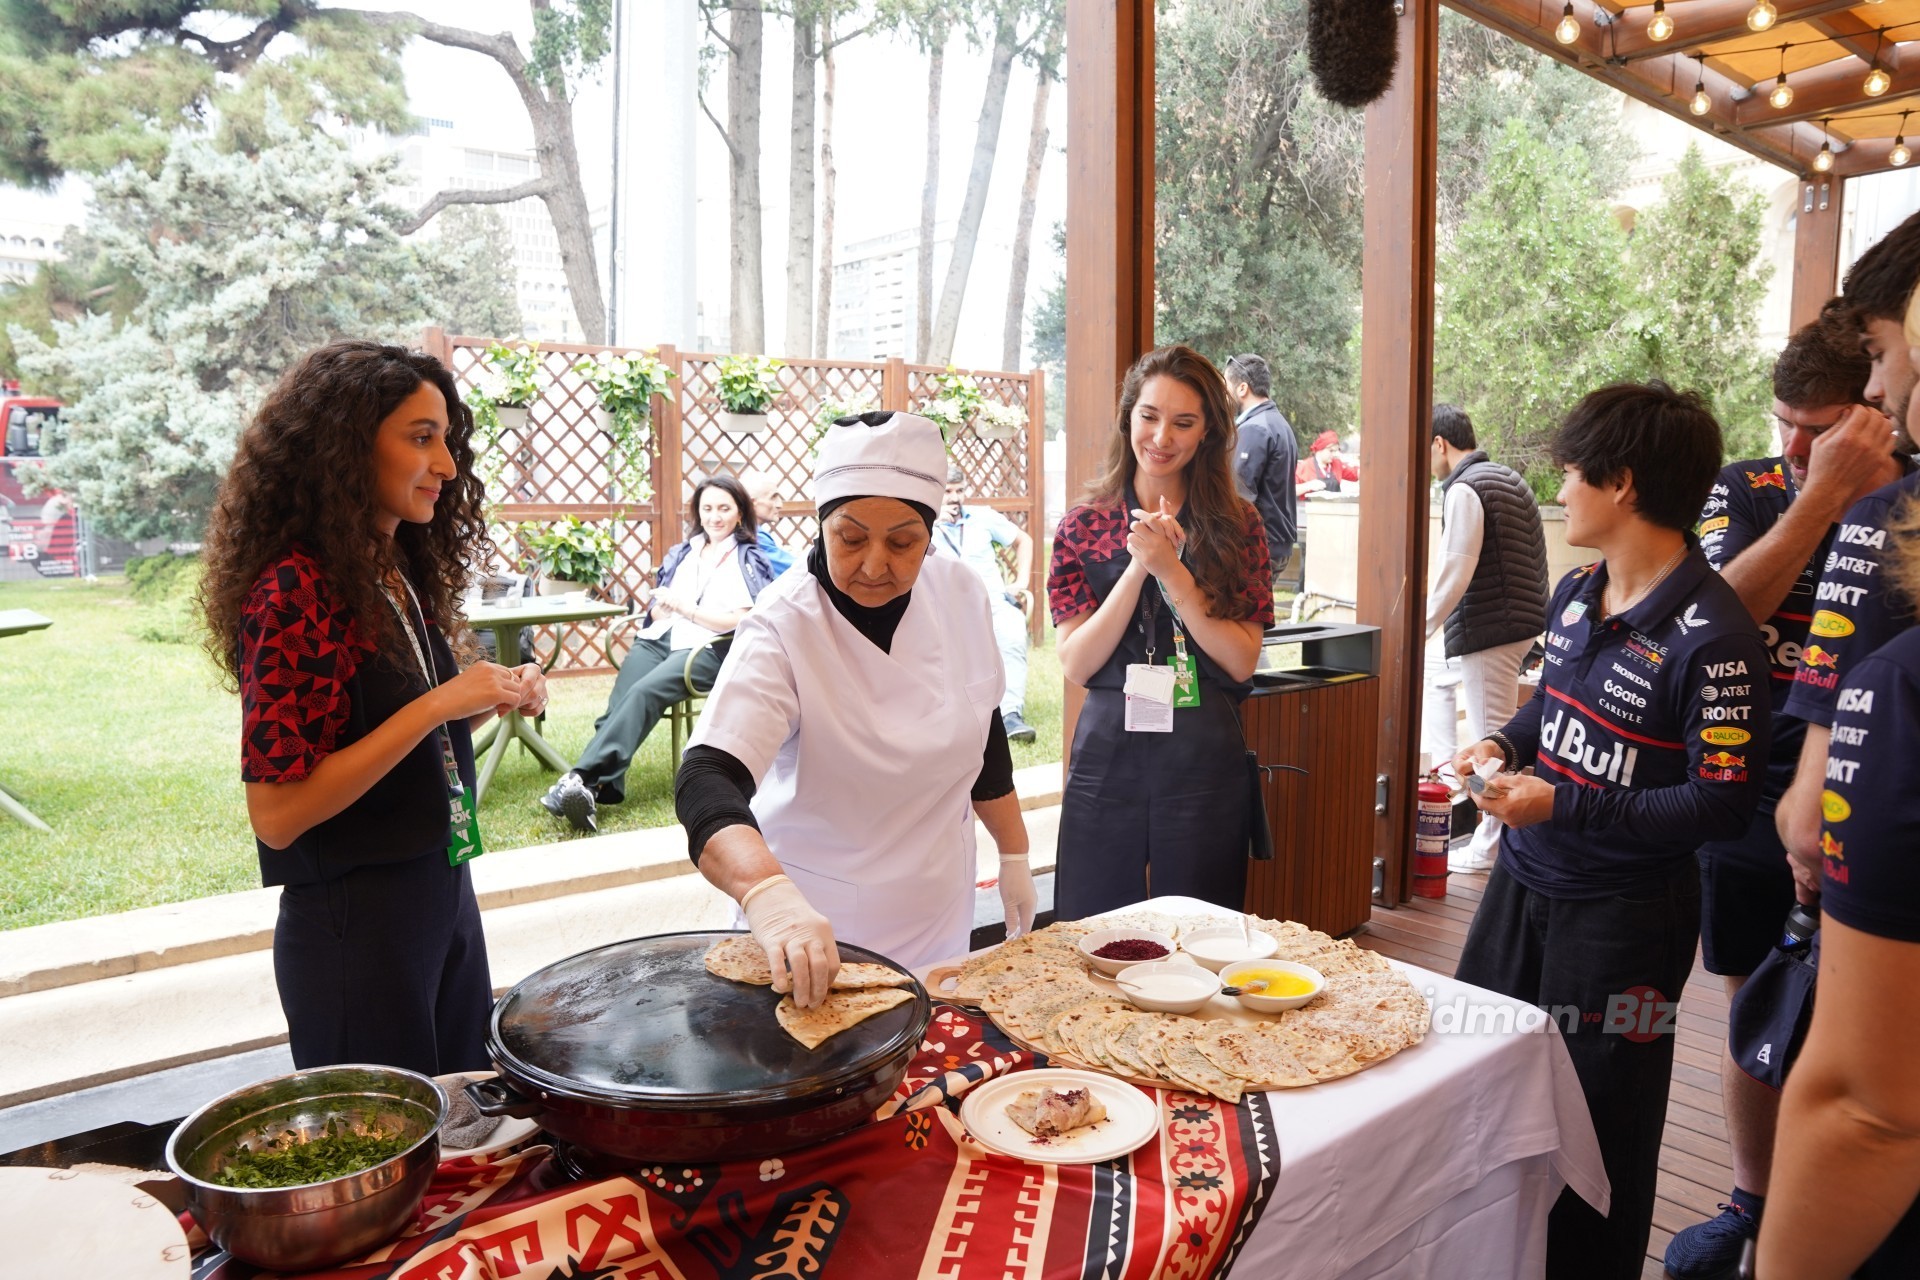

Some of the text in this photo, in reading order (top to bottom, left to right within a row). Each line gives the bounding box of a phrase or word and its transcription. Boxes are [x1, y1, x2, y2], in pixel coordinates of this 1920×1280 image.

[1838, 524, 1888, 550] VISA
[9, 543, 39, 560] 18
[1835, 556, 1879, 576] AT&T
[1816, 582, 1868, 606] ROKT
[1630, 630, 1669, 656] ORACLE
[1620, 648, 1660, 674] RACING
[1702, 660, 1748, 679] VISA
[1611, 662, 1652, 691] HONDA
[1720, 684, 1751, 698] AT&T
[1837, 688, 1874, 714] VISA
[1598, 698, 1643, 724] CARLYLE
[1702, 706, 1751, 721] ROKT
[1713, 730, 1744, 741] RAUCH
[1836, 726, 1869, 746] AT&T
[1826, 757, 1860, 784] OKT
